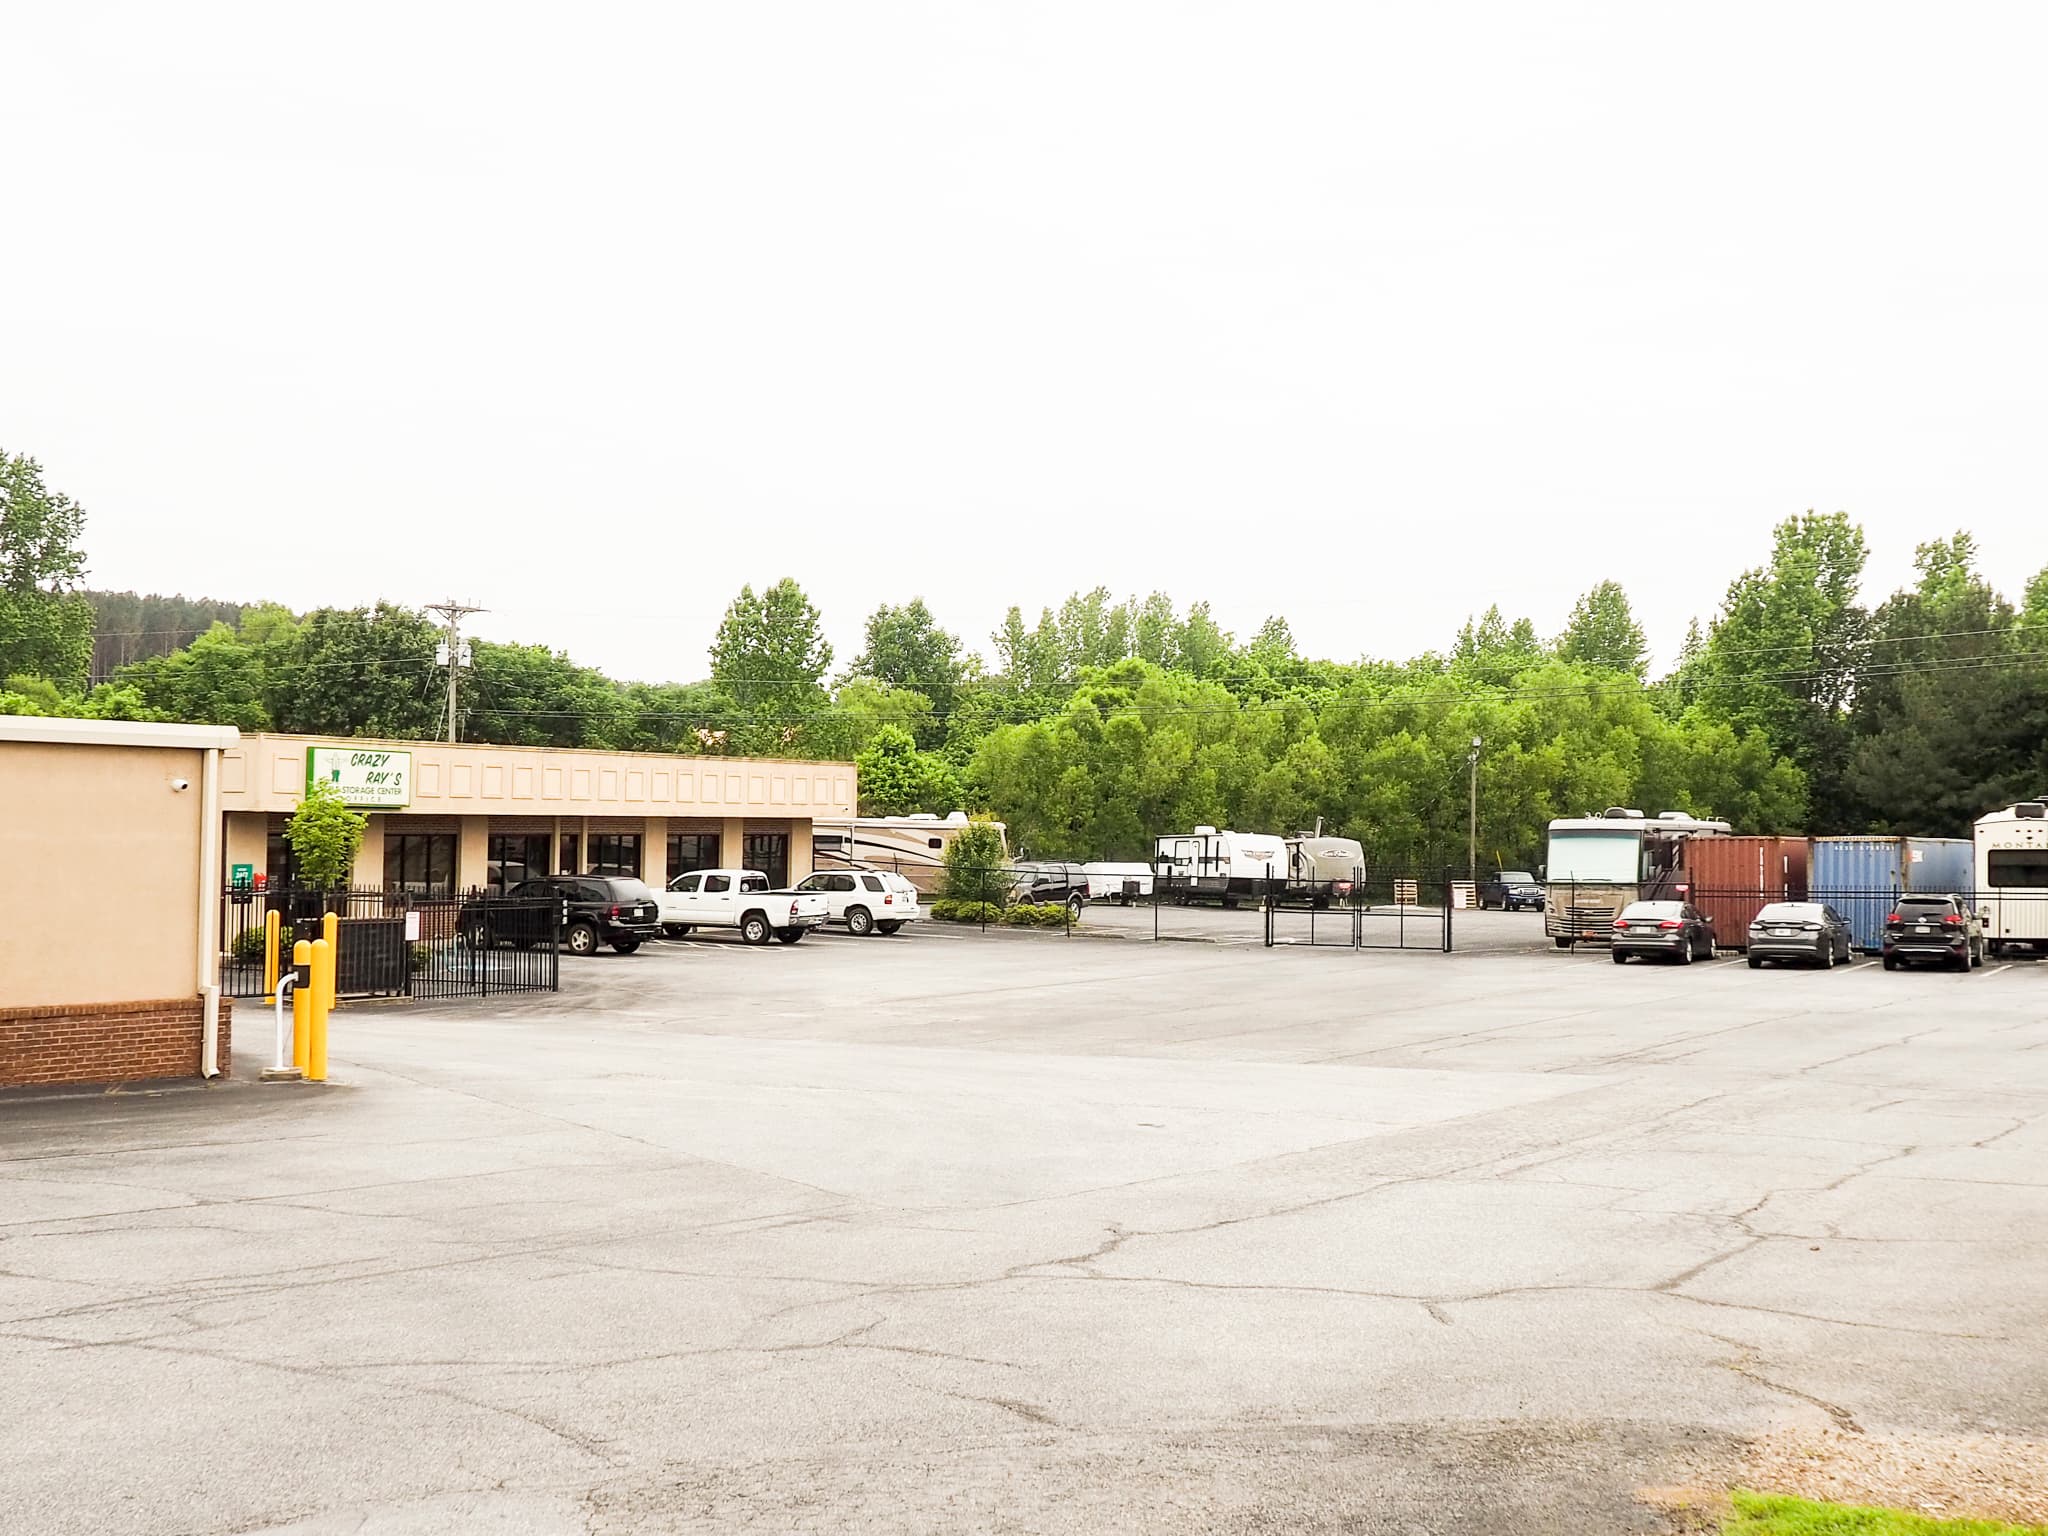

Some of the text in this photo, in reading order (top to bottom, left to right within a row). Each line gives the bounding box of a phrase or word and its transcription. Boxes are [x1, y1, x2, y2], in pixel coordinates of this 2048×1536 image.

[350, 753, 390, 767] CRAZY
[365, 771, 402, 786] RAY'S
[342, 786, 375, 795] STORAGE
[377, 787, 402, 795] CENTER
[1992, 841, 2048, 849] MONTA
